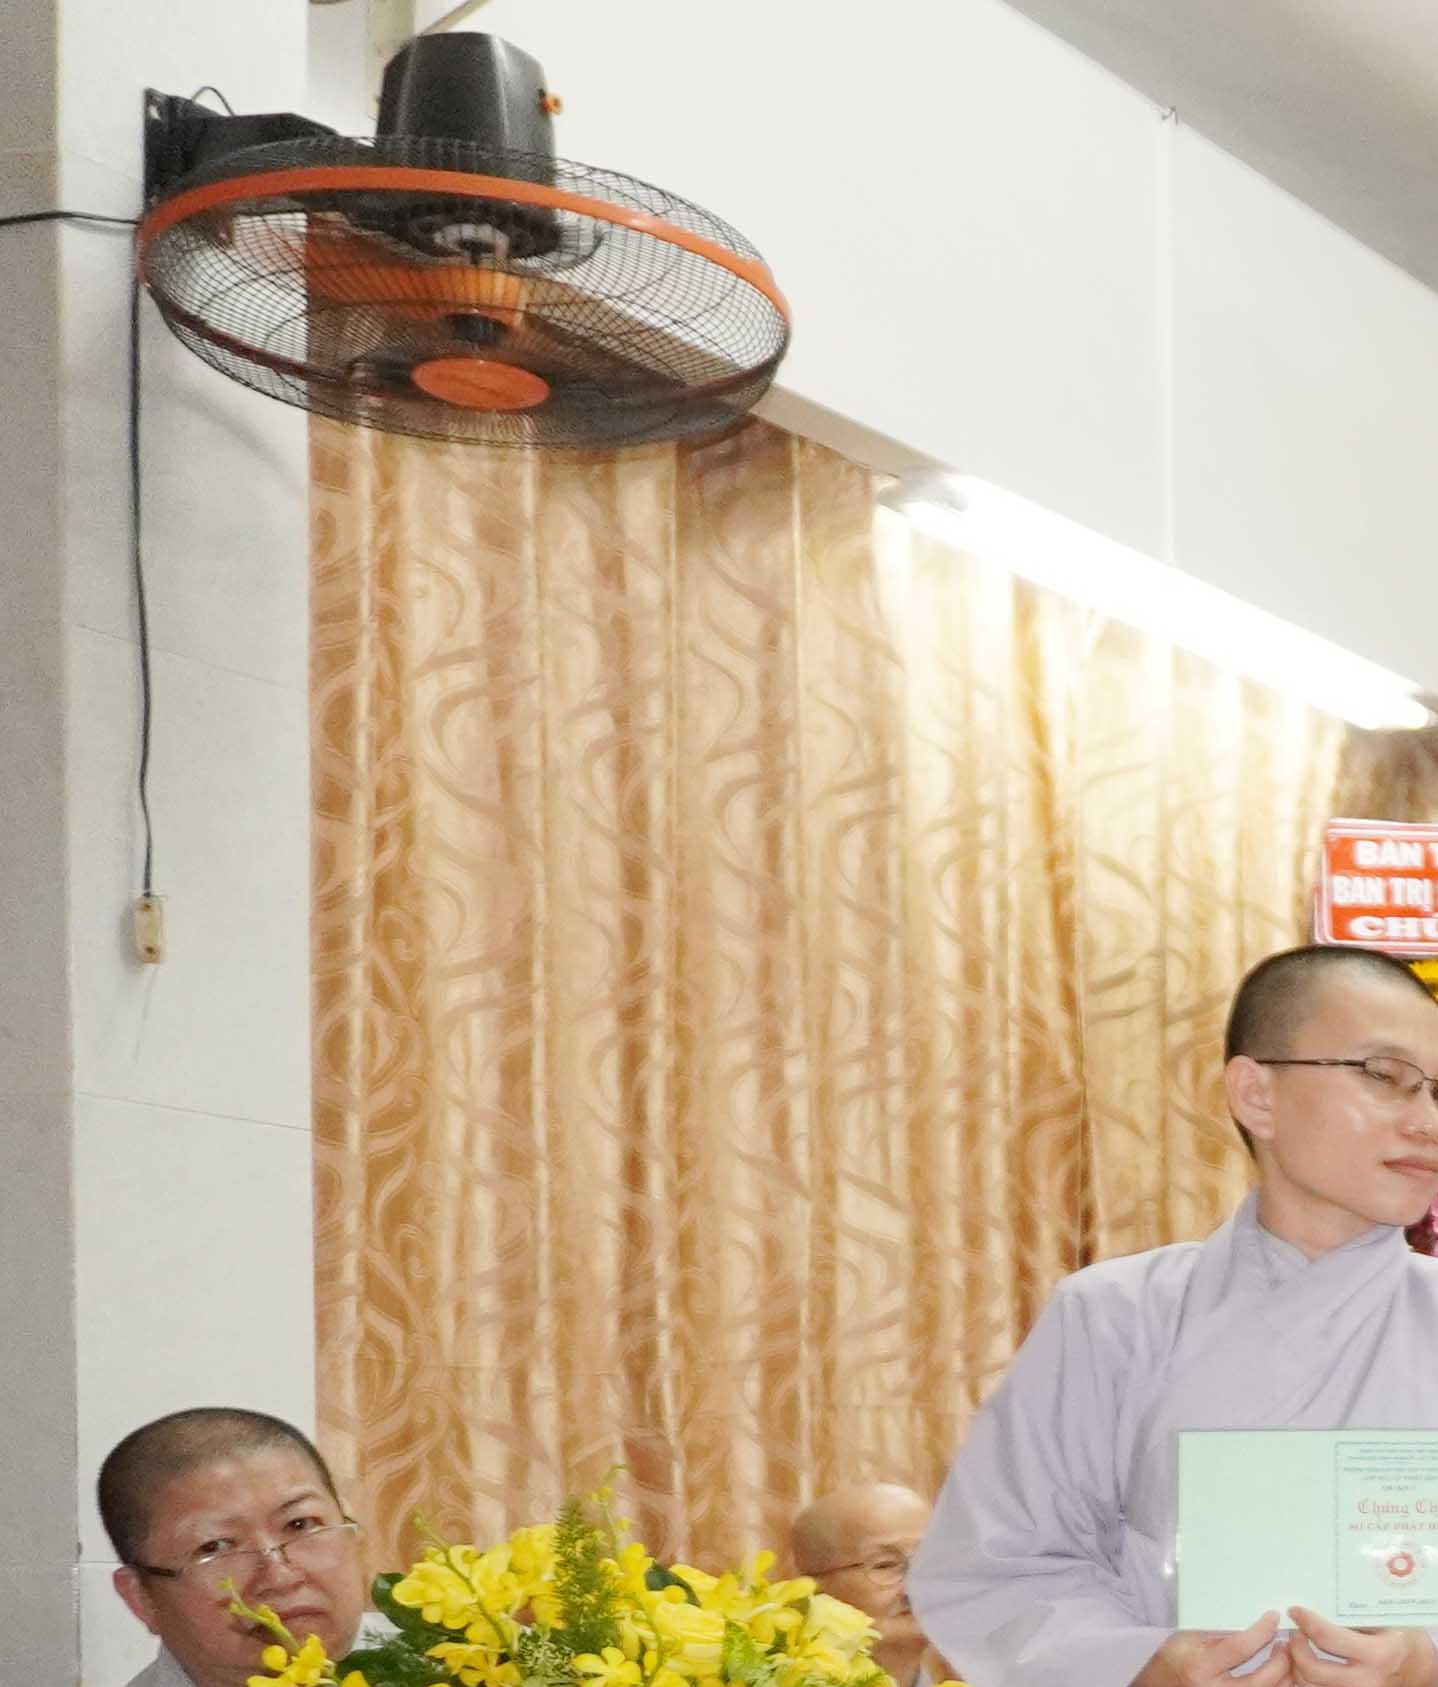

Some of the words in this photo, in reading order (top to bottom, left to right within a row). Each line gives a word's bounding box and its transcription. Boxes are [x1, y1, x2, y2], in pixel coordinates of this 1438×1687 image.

[1355, 839, 1425, 869] BAN
[1332, 875, 1385, 907] BAN
[1388, 876, 1433, 913] TRỊ
